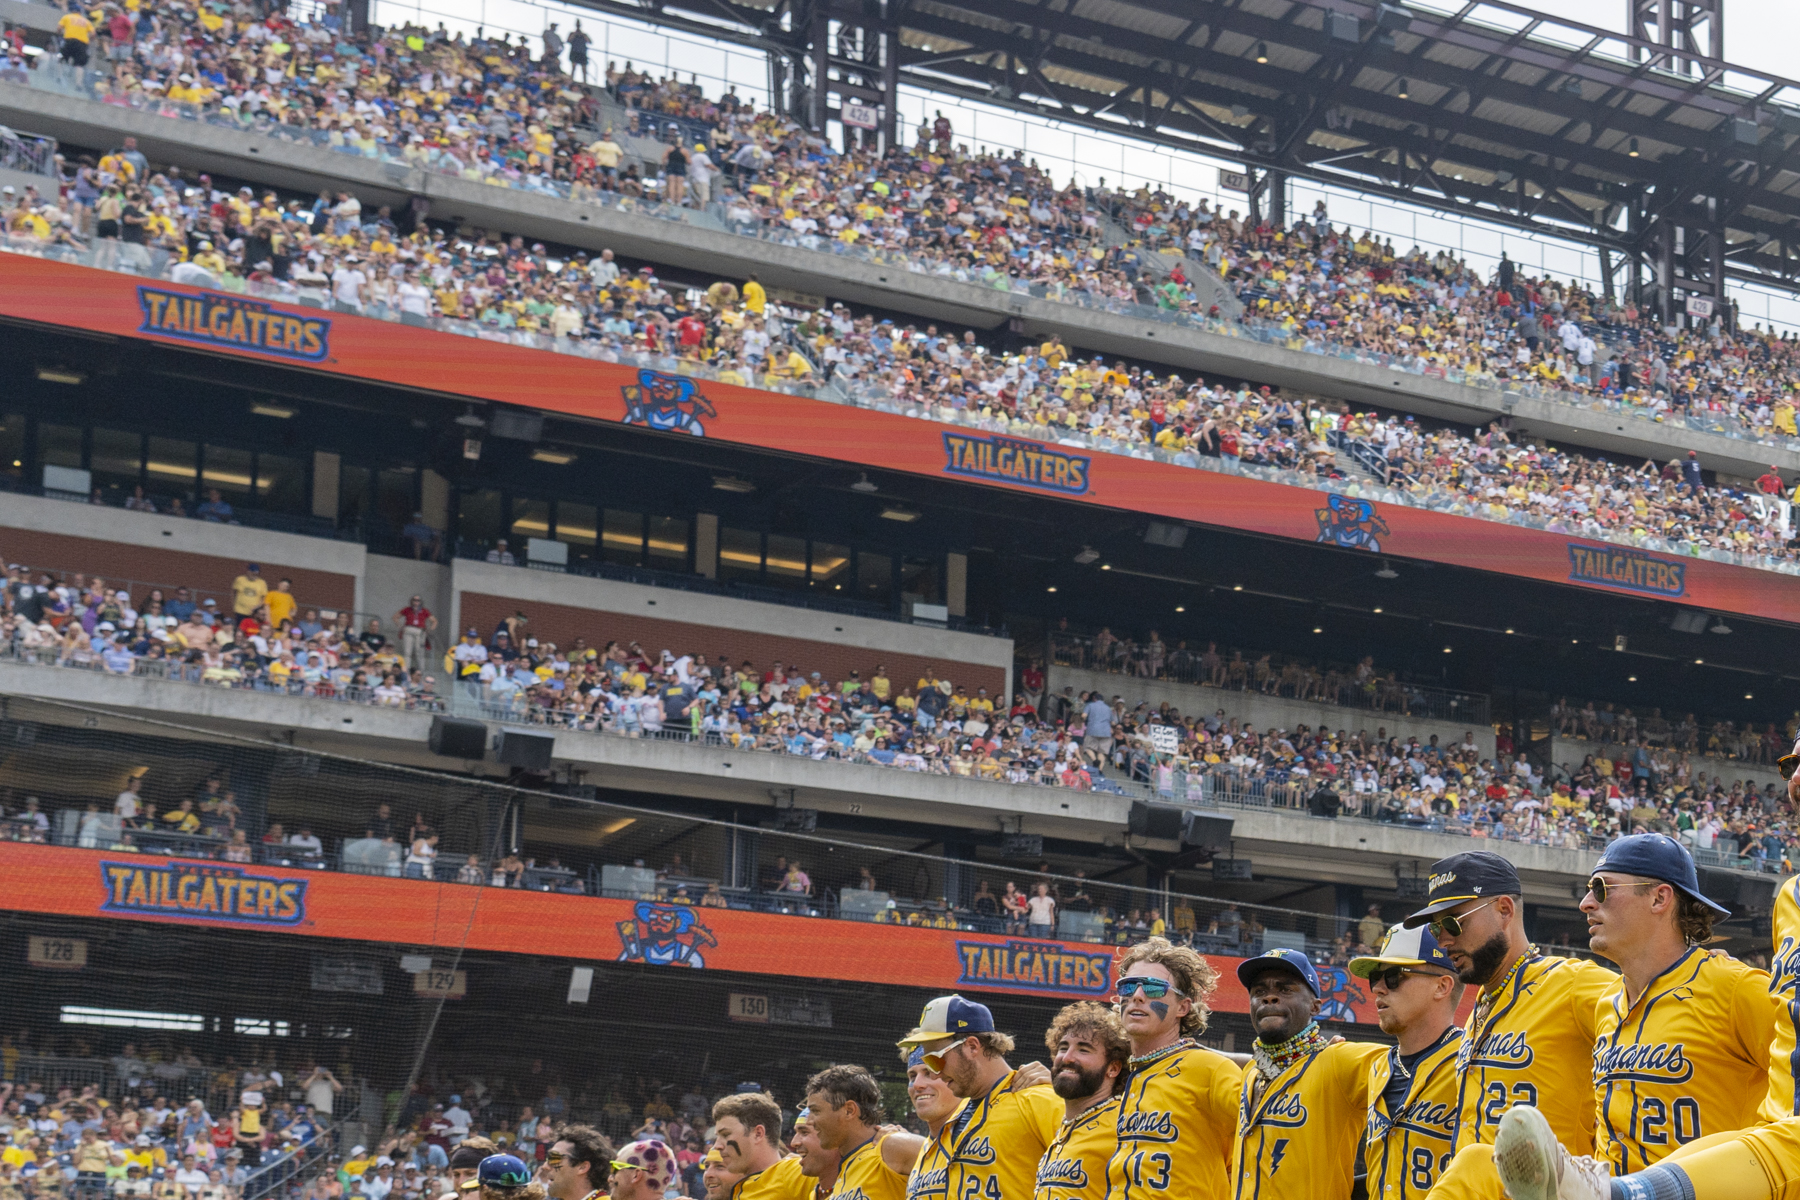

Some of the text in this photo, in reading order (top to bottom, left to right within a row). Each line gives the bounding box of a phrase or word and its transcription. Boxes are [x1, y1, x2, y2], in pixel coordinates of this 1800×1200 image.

[848, 107, 870, 122] 426
[1225, 174, 1245, 187] 427
[146, 295, 321, 354] TAILGATERS
[948, 438, 1084, 484] TAILGATERS
[1572, 547, 1681, 590] TAILGATERS
[108, 867, 298, 917] TAILGATERS
[426, 970, 455, 990] 129
[963, 946, 1102, 988] TAILGATERS
[739, 998, 766, 1016] 130
[1641, 1096, 1701, 1145] 20
[1132, 1150, 1172, 1191] 13
